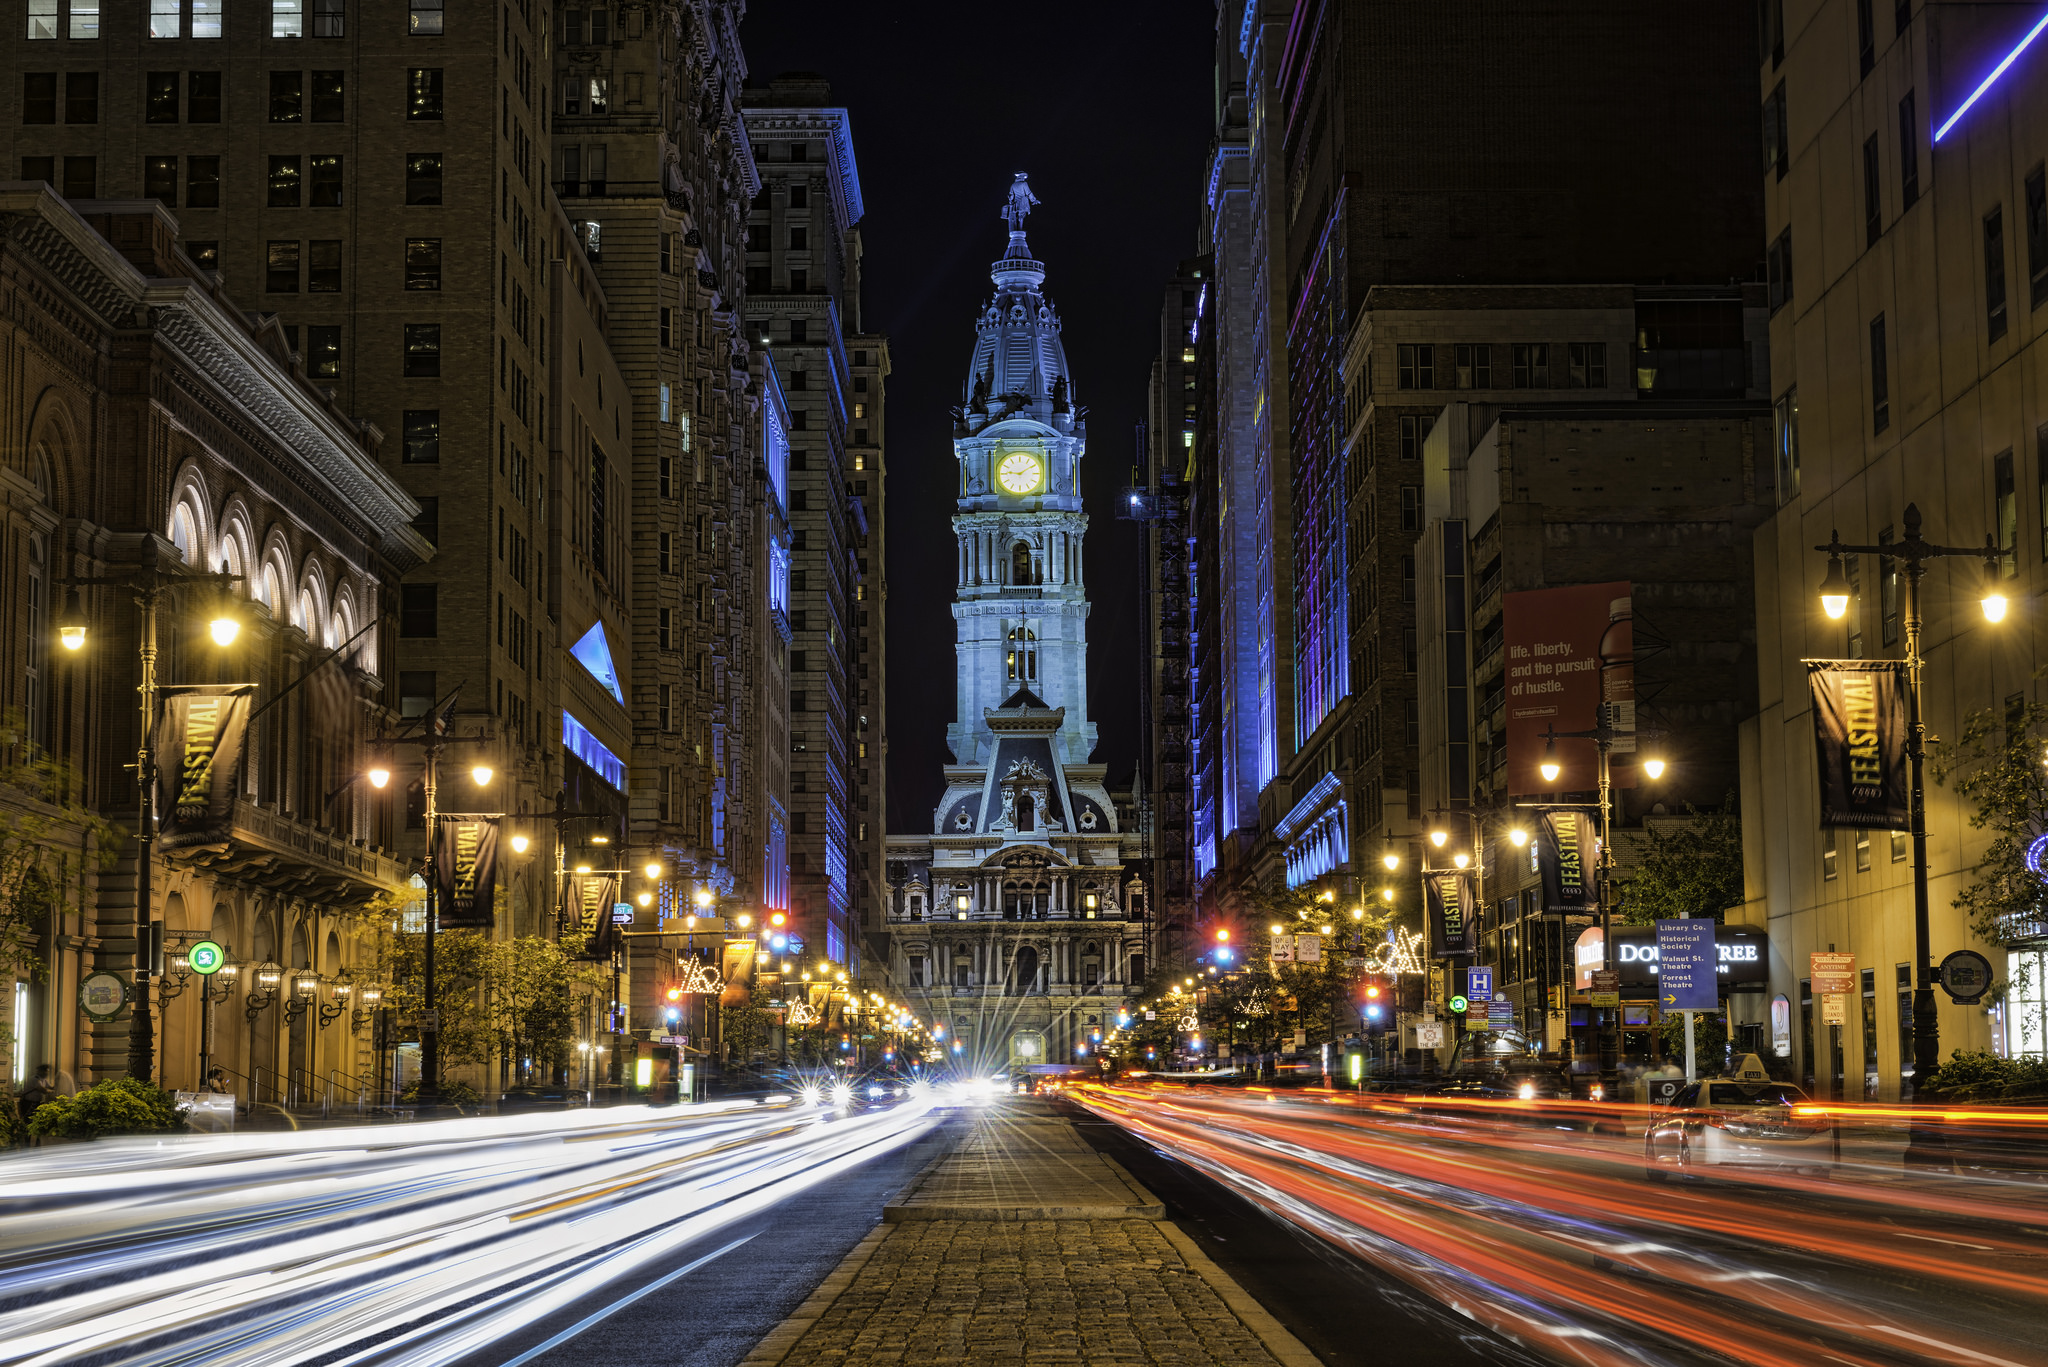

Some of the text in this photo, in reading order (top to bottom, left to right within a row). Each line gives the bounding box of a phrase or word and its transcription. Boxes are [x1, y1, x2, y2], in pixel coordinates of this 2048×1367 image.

[1510, 641, 1573, 659] life. liberty.
[1511, 658, 1595, 678] and the pursuit
[1511, 680, 1565, 696] of hustle.
[1842, 674, 1882, 786] FEASTIVAL
[1555, 812, 1581, 886] FEASTIVAL
[454, 823, 478, 900] FEASTIVAL
[581, 880, 600, 934] EASTIVAL
[614, 906, 626, 914] UST
[1440, 876, 1462, 936] FEASTIVAL
[1472, 974, 1487, 989] H
[1745, 1071, 1761, 1079] TAXI
